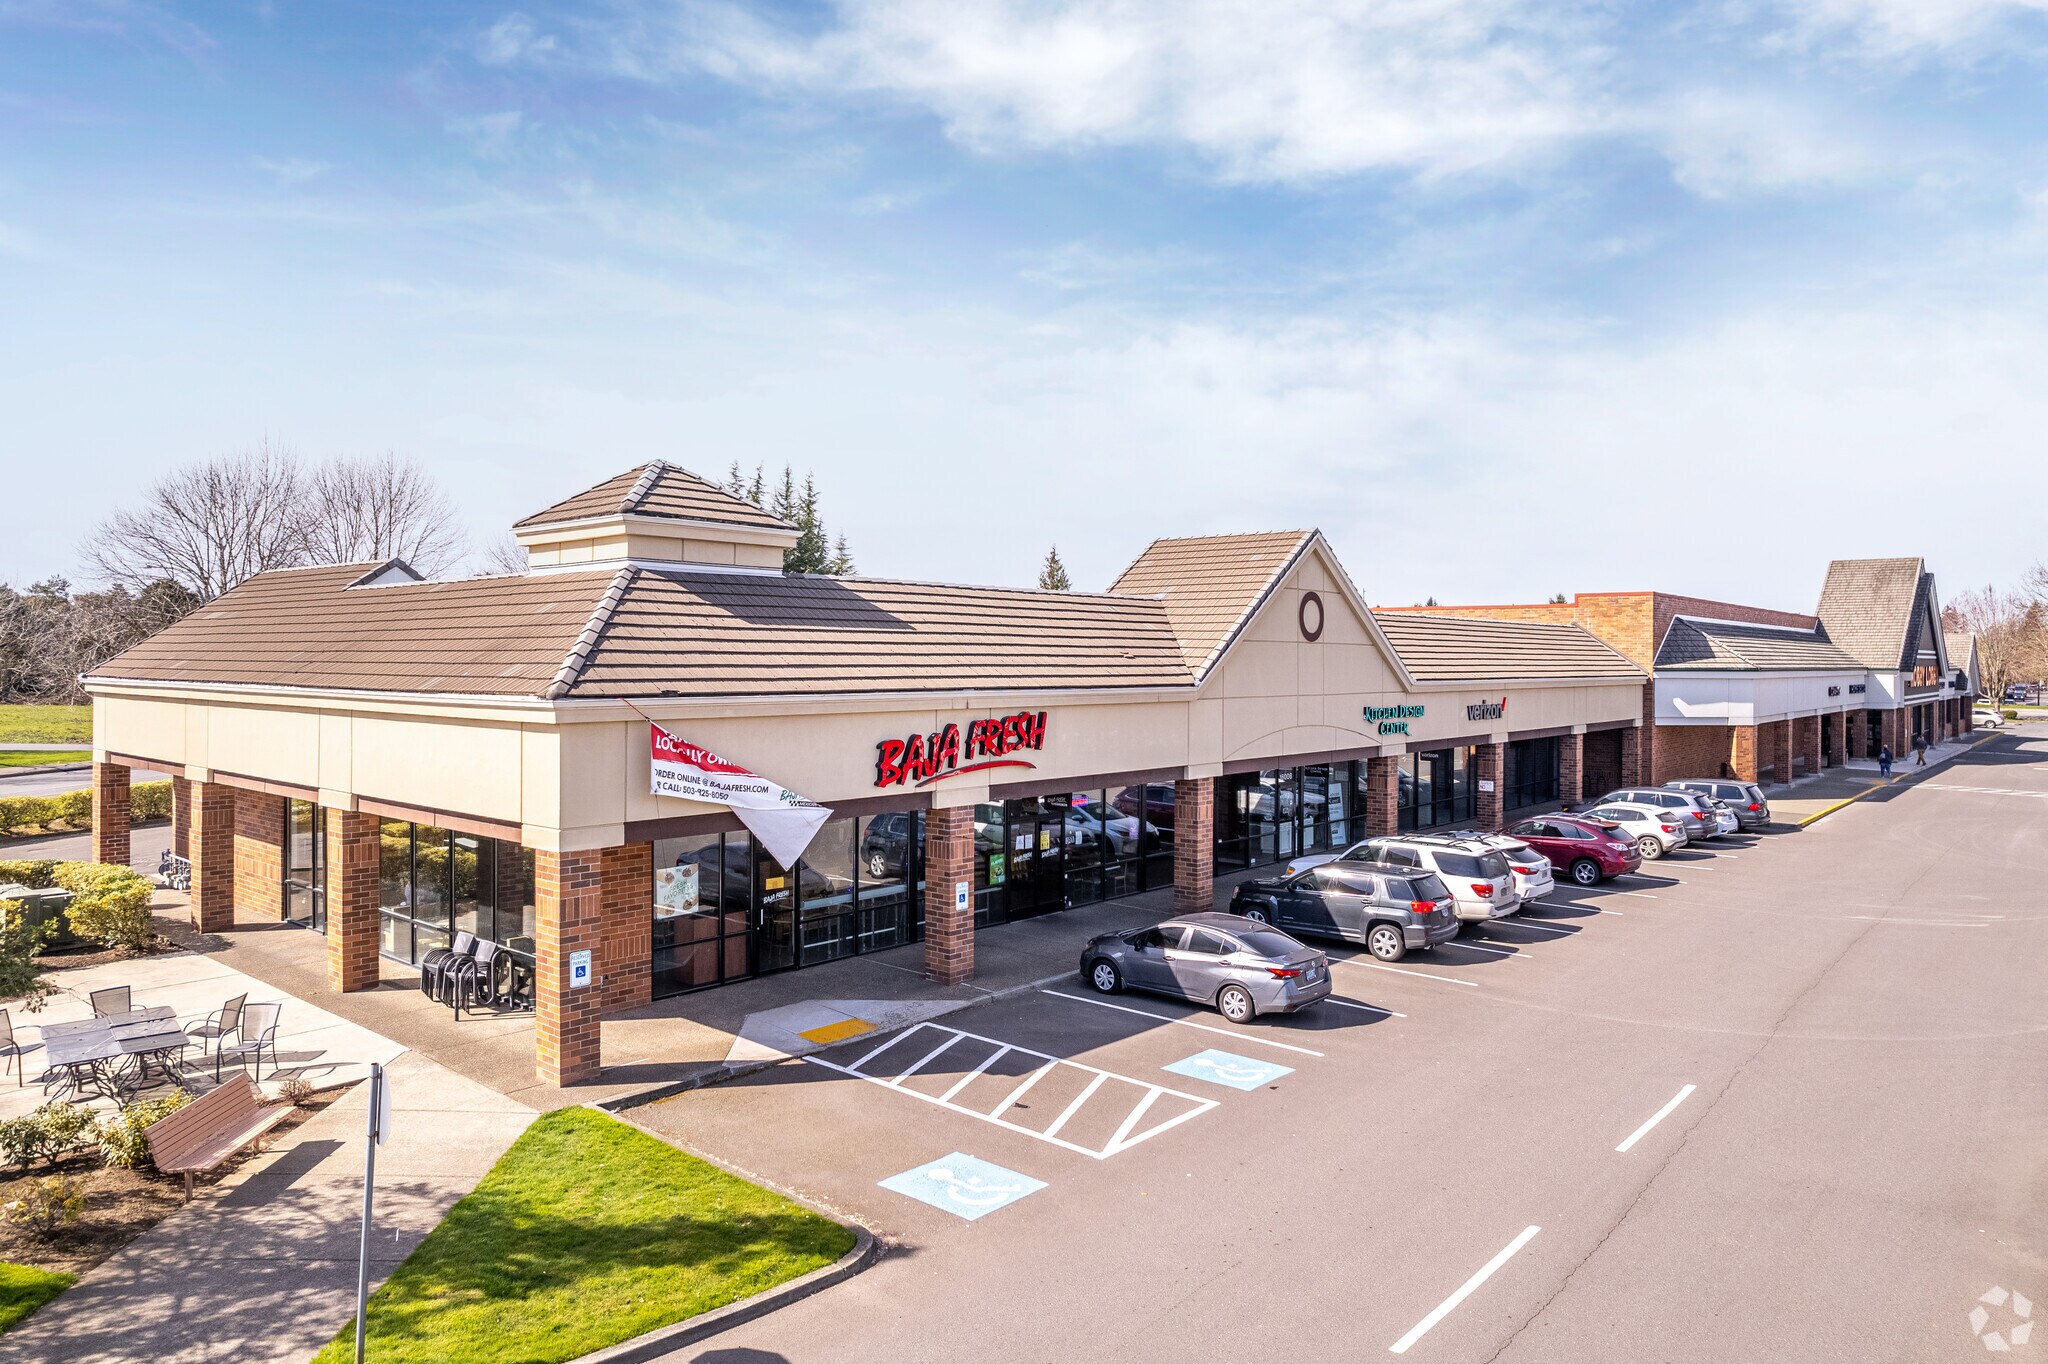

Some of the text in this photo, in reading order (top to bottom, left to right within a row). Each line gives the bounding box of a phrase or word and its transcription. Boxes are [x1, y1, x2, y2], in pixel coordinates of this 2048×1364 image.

[1363, 704, 1425, 723] KITCHEN DESIGN
[1467, 700, 1502, 720] verizon
[1379, 721, 1412, 736] CENTER
[874, 711, 1048, 788] BAJA FRESH
[677, 773, 701, 785] ONLINE
[709, 781, 769, 794] BAJAFRESH.COM
[682, 786, 729, 801] 503-925-8050
